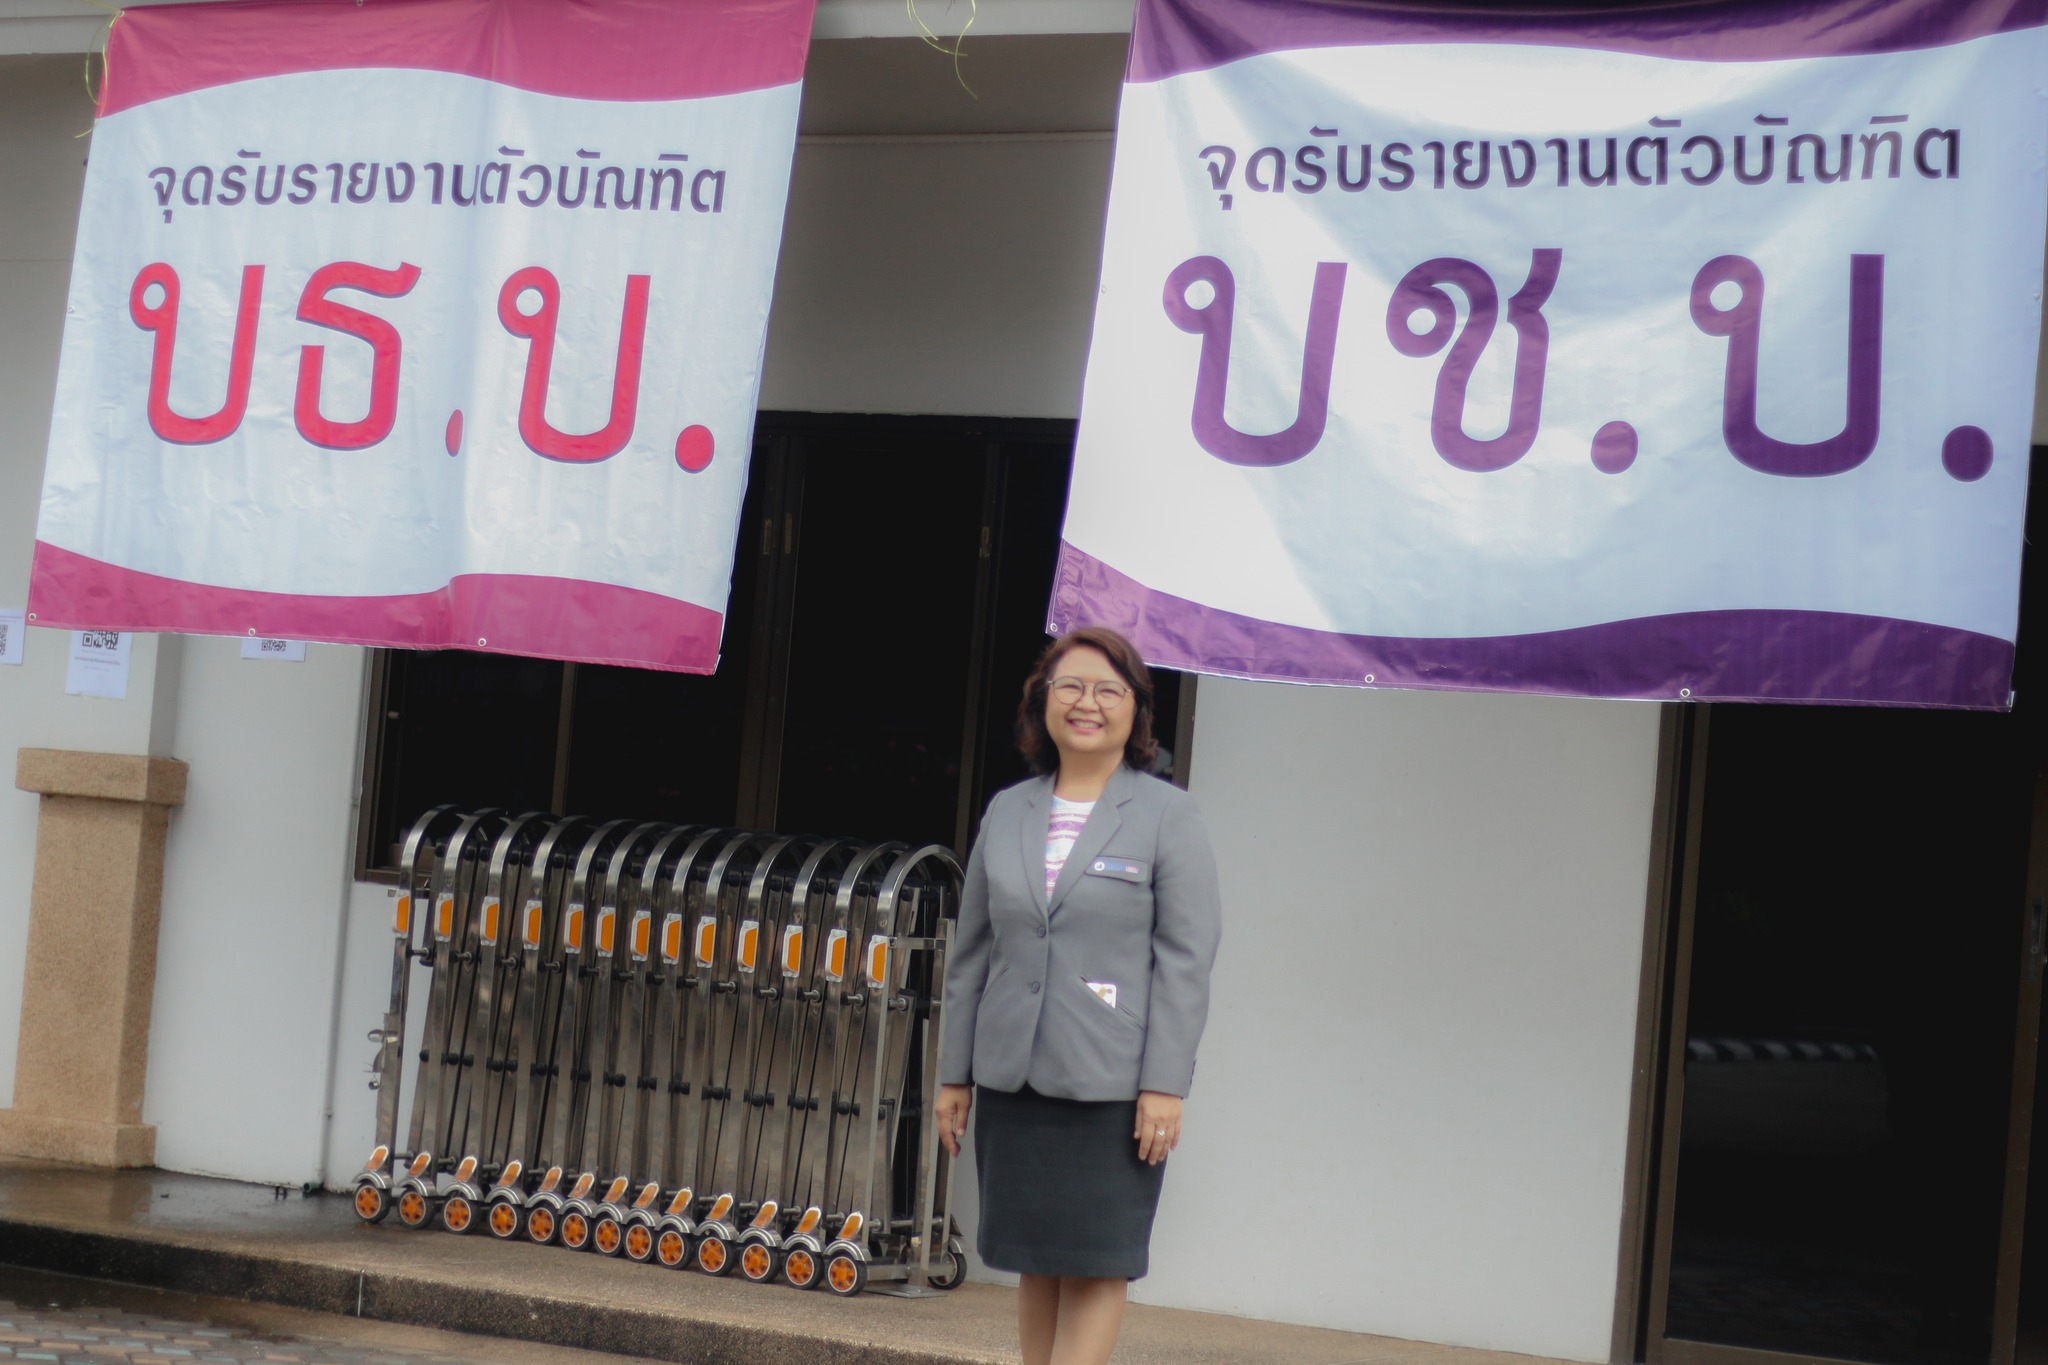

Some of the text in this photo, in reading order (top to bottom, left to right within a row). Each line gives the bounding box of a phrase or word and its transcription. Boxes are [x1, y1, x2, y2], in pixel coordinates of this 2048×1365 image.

[147, 145, 727, 224] จุดรับรายงานตัวบัณฑิต
[1197, 113, 1962, 211] จุดรับรายงานตัวบัณฑิต
[129, 260, 716, 475] บธ.บ.
[1163, 247, 1995, 483] บช.บ.
